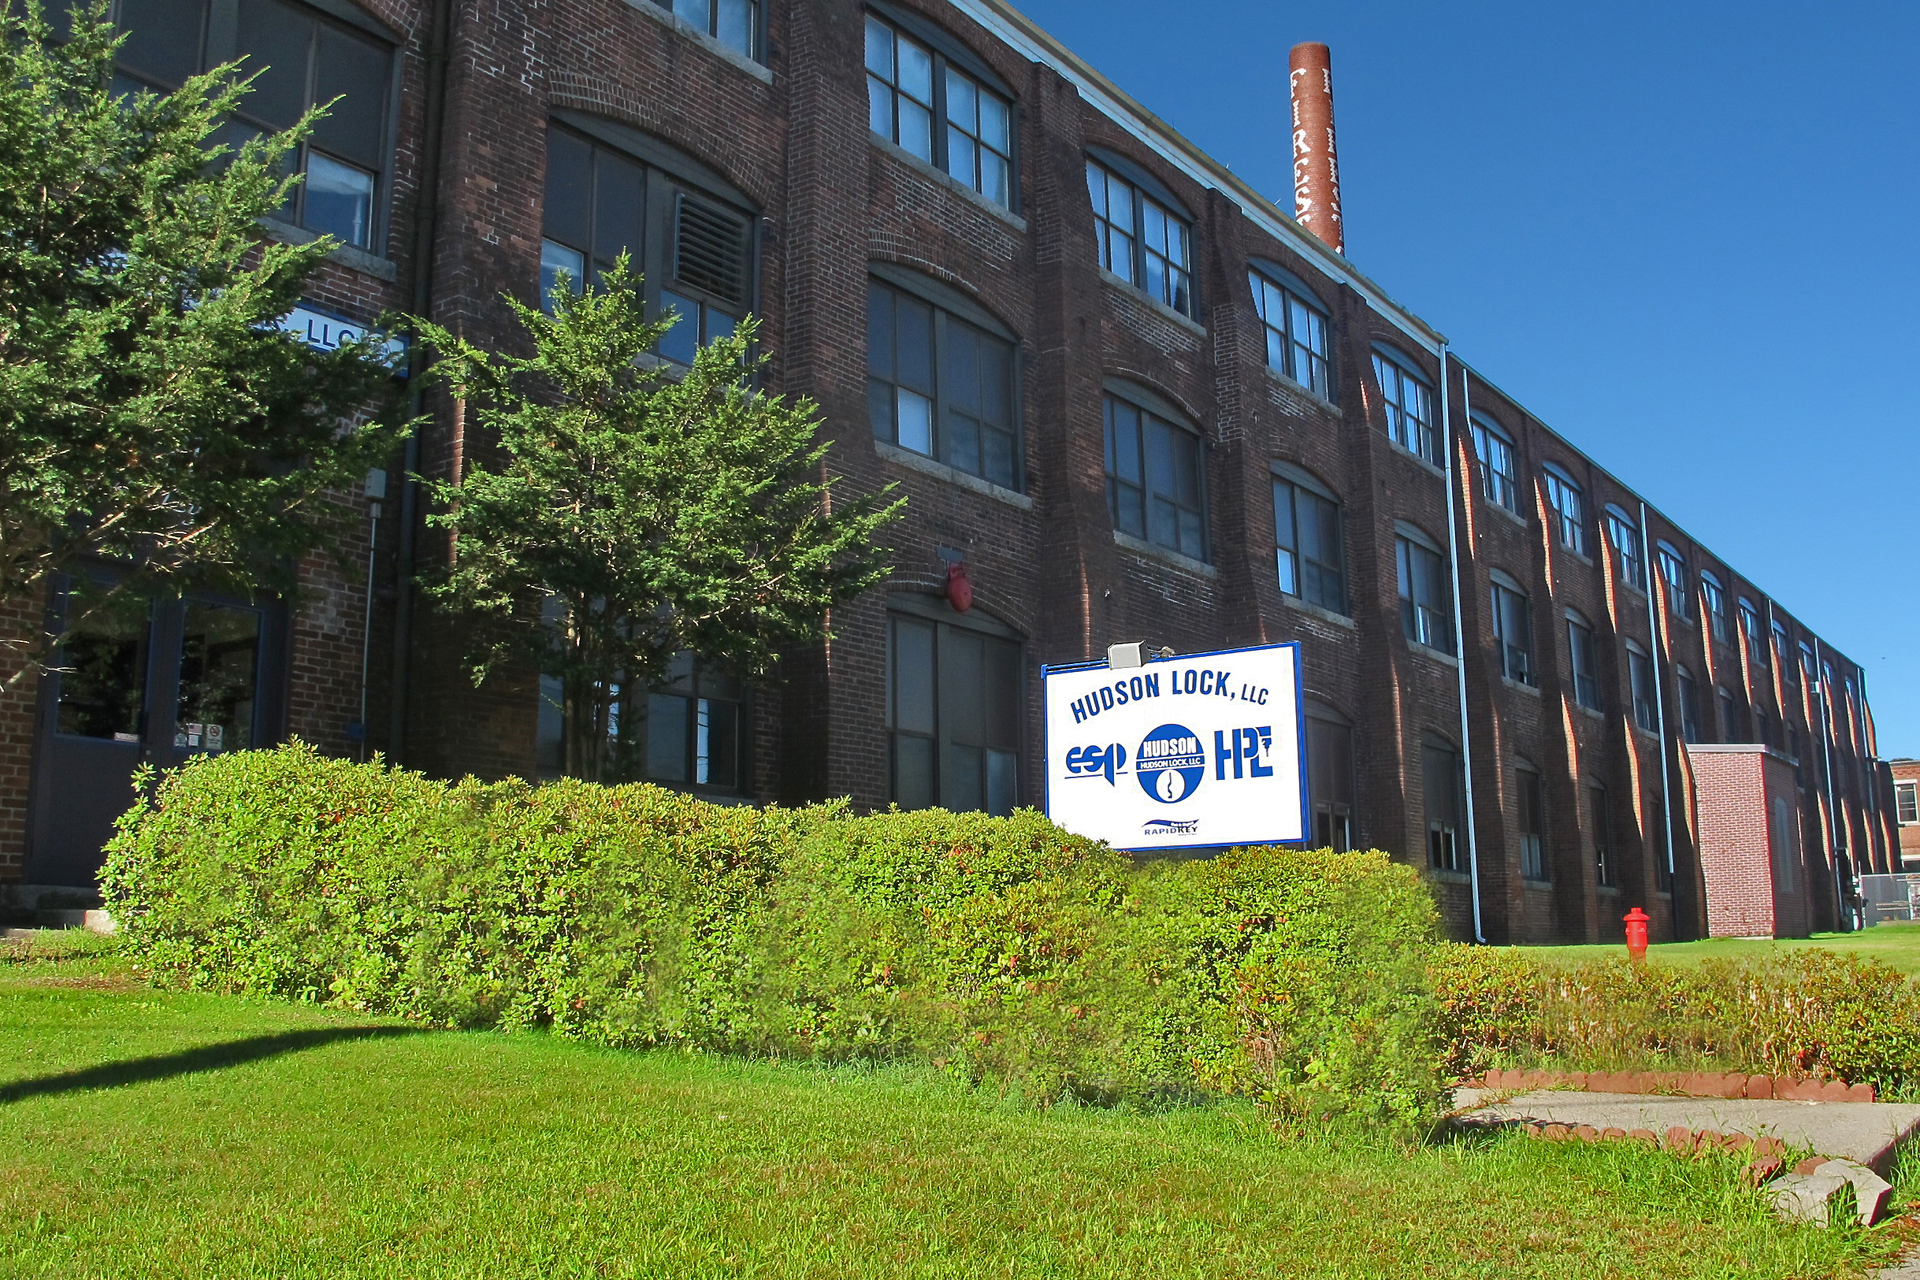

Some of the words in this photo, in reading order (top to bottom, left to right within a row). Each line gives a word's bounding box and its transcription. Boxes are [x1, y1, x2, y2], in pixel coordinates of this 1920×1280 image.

[1070, 673, 1160, 724] HUDSON
[1172, 669, 1236, 701] LOCK,
[1241, 683, 1269, 706] LLC
[1143, 737, 1197, 758] HUDSON
[1140, 760, 1168, 769] HUDSON
[1188, 757, 1201, 765] LLC
